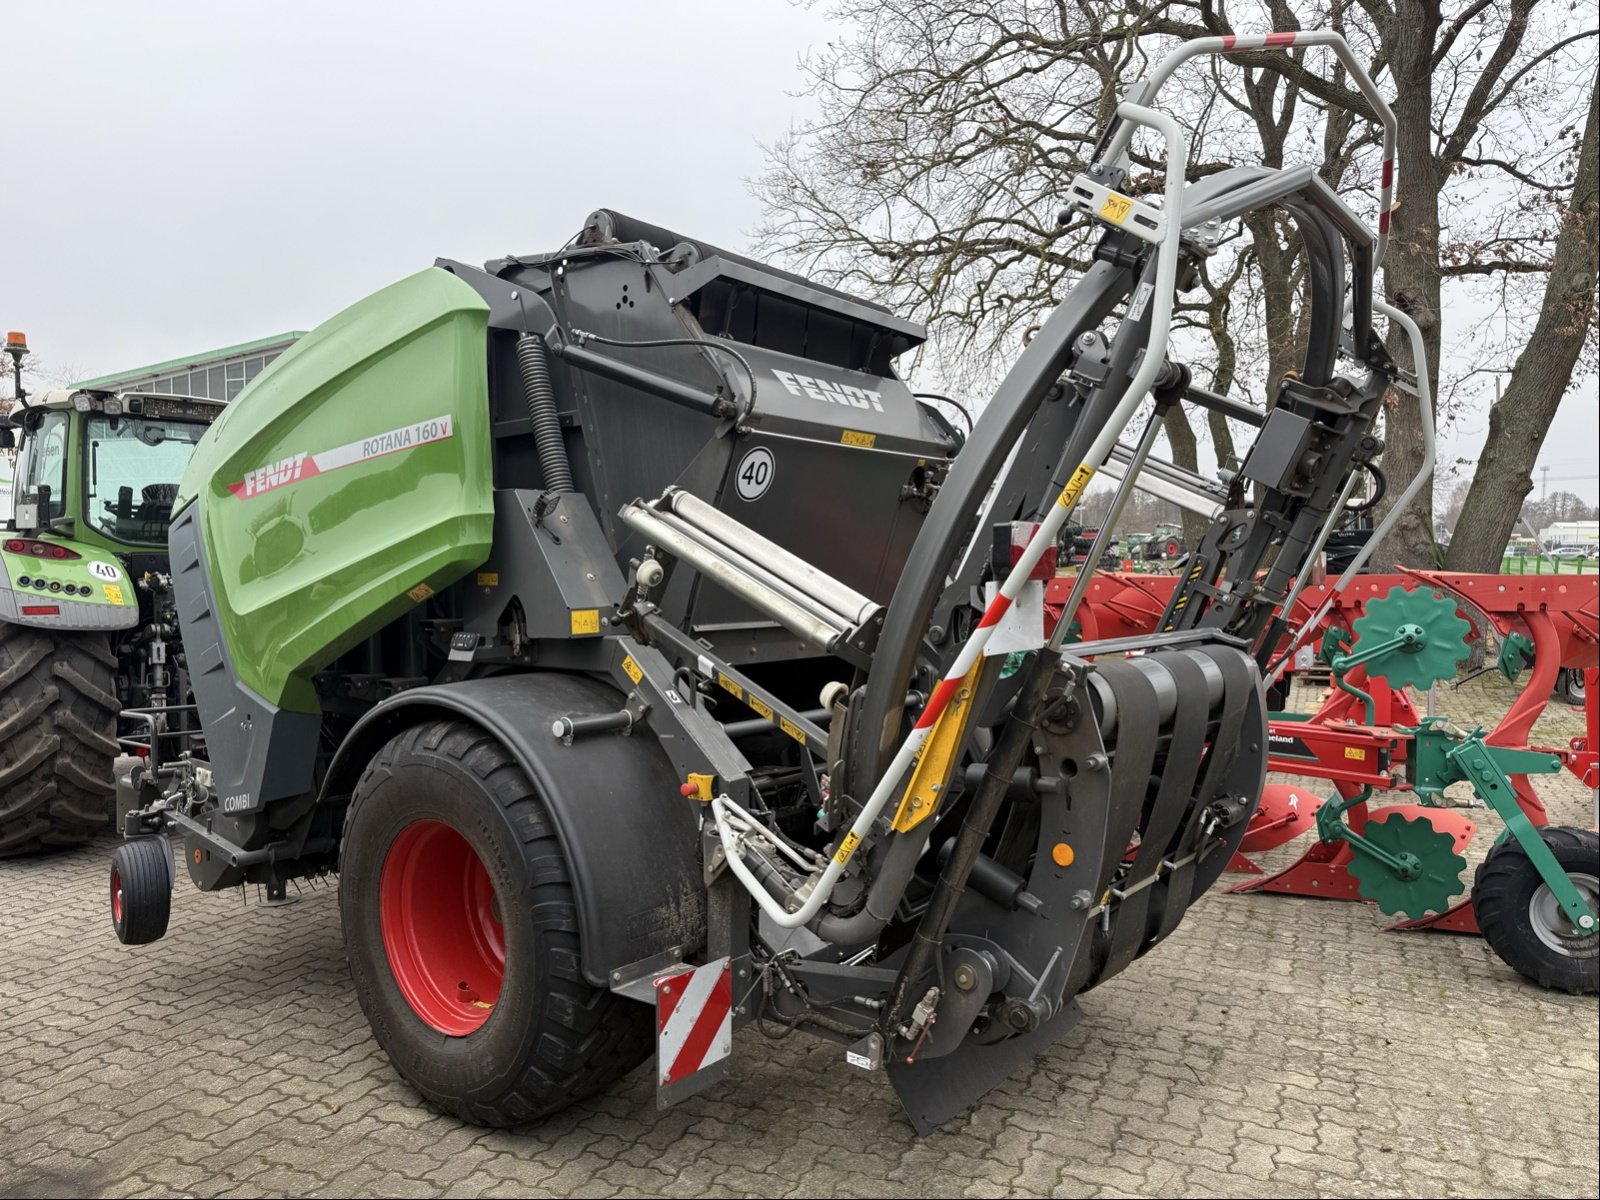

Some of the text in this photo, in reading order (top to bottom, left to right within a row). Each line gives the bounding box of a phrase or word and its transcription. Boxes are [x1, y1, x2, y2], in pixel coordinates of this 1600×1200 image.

[771, 368, 885, 413] FENDT
[362, 421, 449, 457] ROTANA 160 V
[243, 450, 308, 497] FENDT
[741, 461, 769, 486] 40
[96, 564, 117, 578] 40
[224, 793, 250, 812] COMBI
